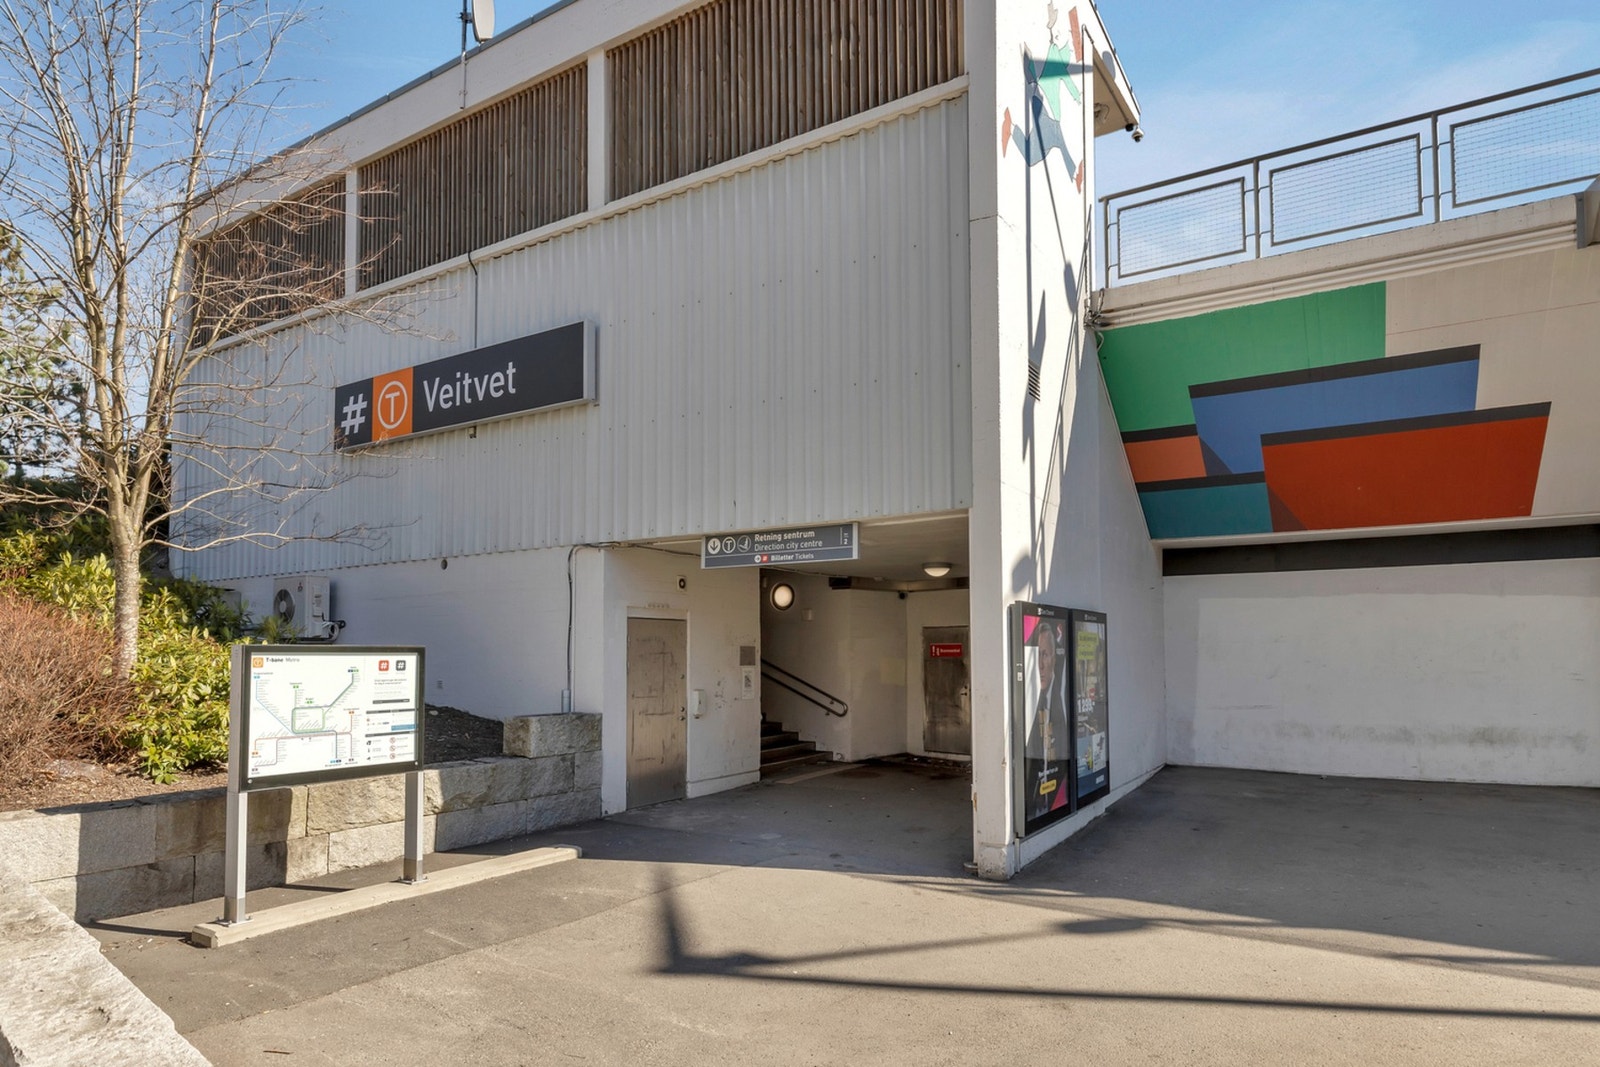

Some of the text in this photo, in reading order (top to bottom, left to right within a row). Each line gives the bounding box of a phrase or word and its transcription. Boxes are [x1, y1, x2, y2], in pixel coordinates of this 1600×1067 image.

[423, 361, 516, 413] Veitvet
[754, 531, 815, 542] Retning sentrum
[754, 540, 823, 551] Direction city centre
[770, 554, 794, 562] Billetter
